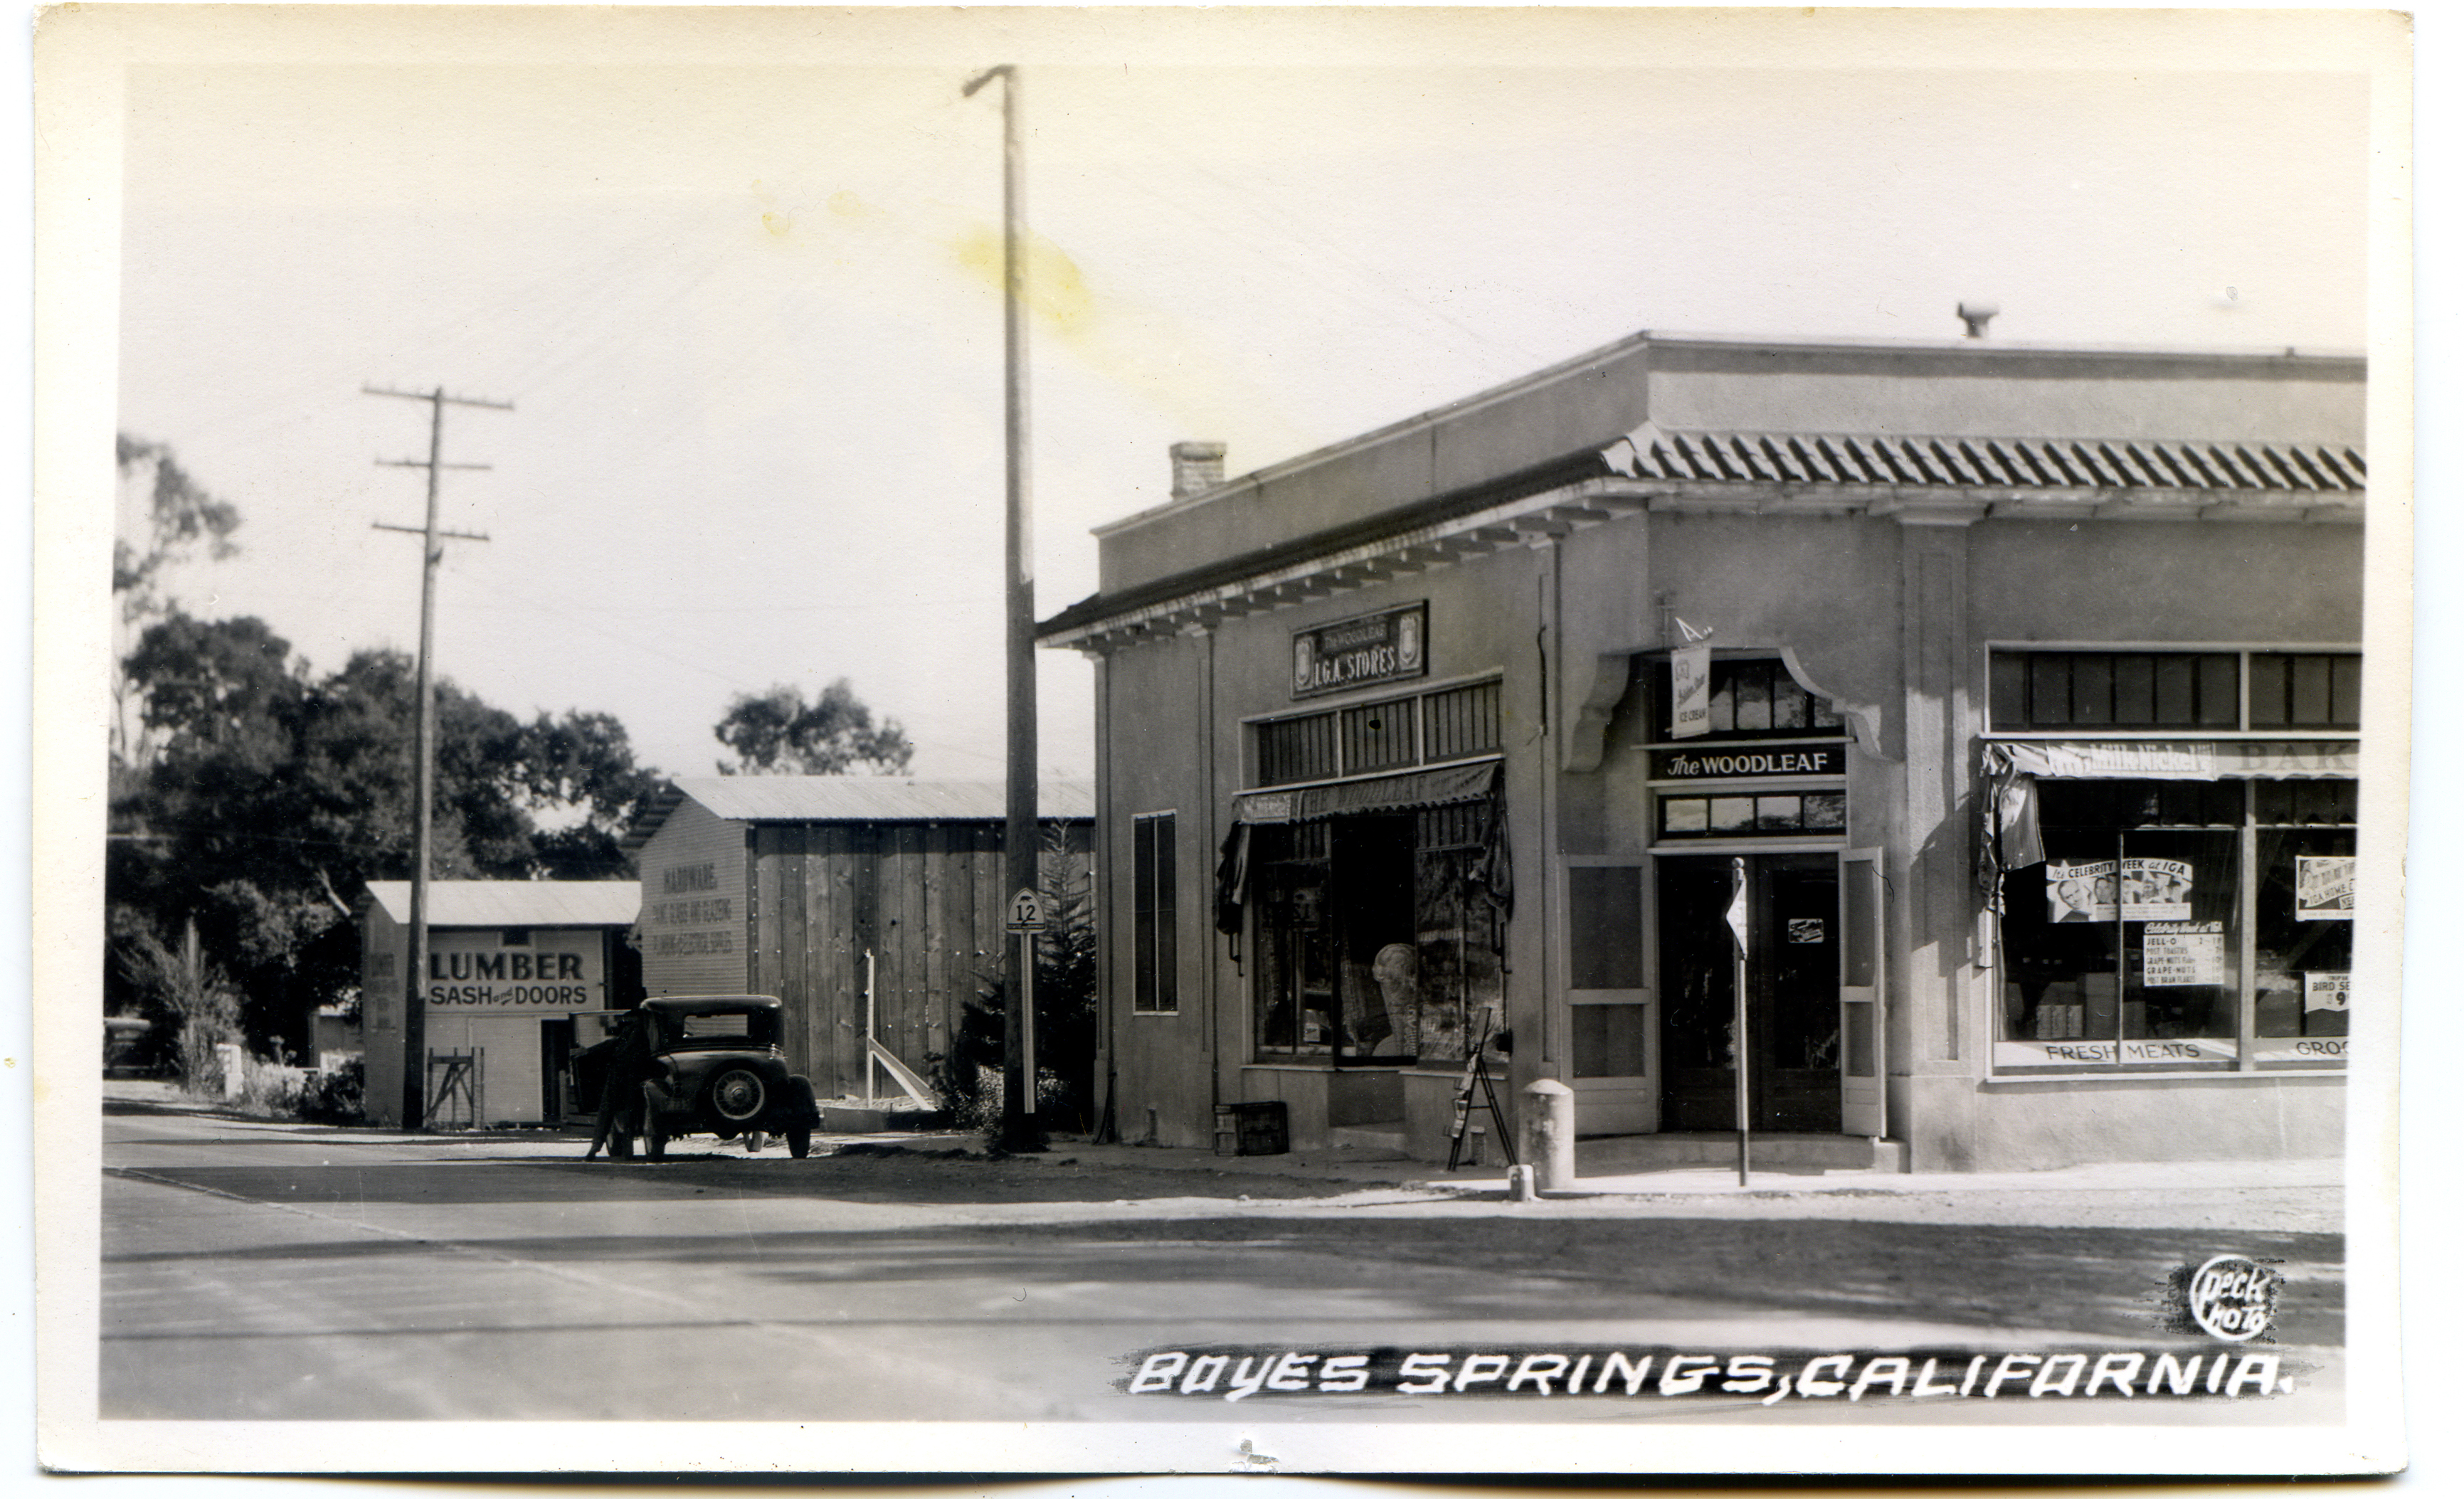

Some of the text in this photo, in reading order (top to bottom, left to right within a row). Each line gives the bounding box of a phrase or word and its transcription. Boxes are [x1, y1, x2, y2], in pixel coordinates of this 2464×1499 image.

[1347, 645, 1395, 679] STORES
[1668, 753, 1828, 775] The WOODLEAF
[2068, 862, 2113, 878] CELEBRITY
[2162, 862, 2185, 875] IGA
[1016, 904, 1036, 921] 12
[429, 952, 585, 981] LUMBER
[430, 985, 587, 1007] SASH and DOORS
[2312, 982, 2335, 992] BIRD
[2046, 1043, 2200, 1061] FRESH MEATS
